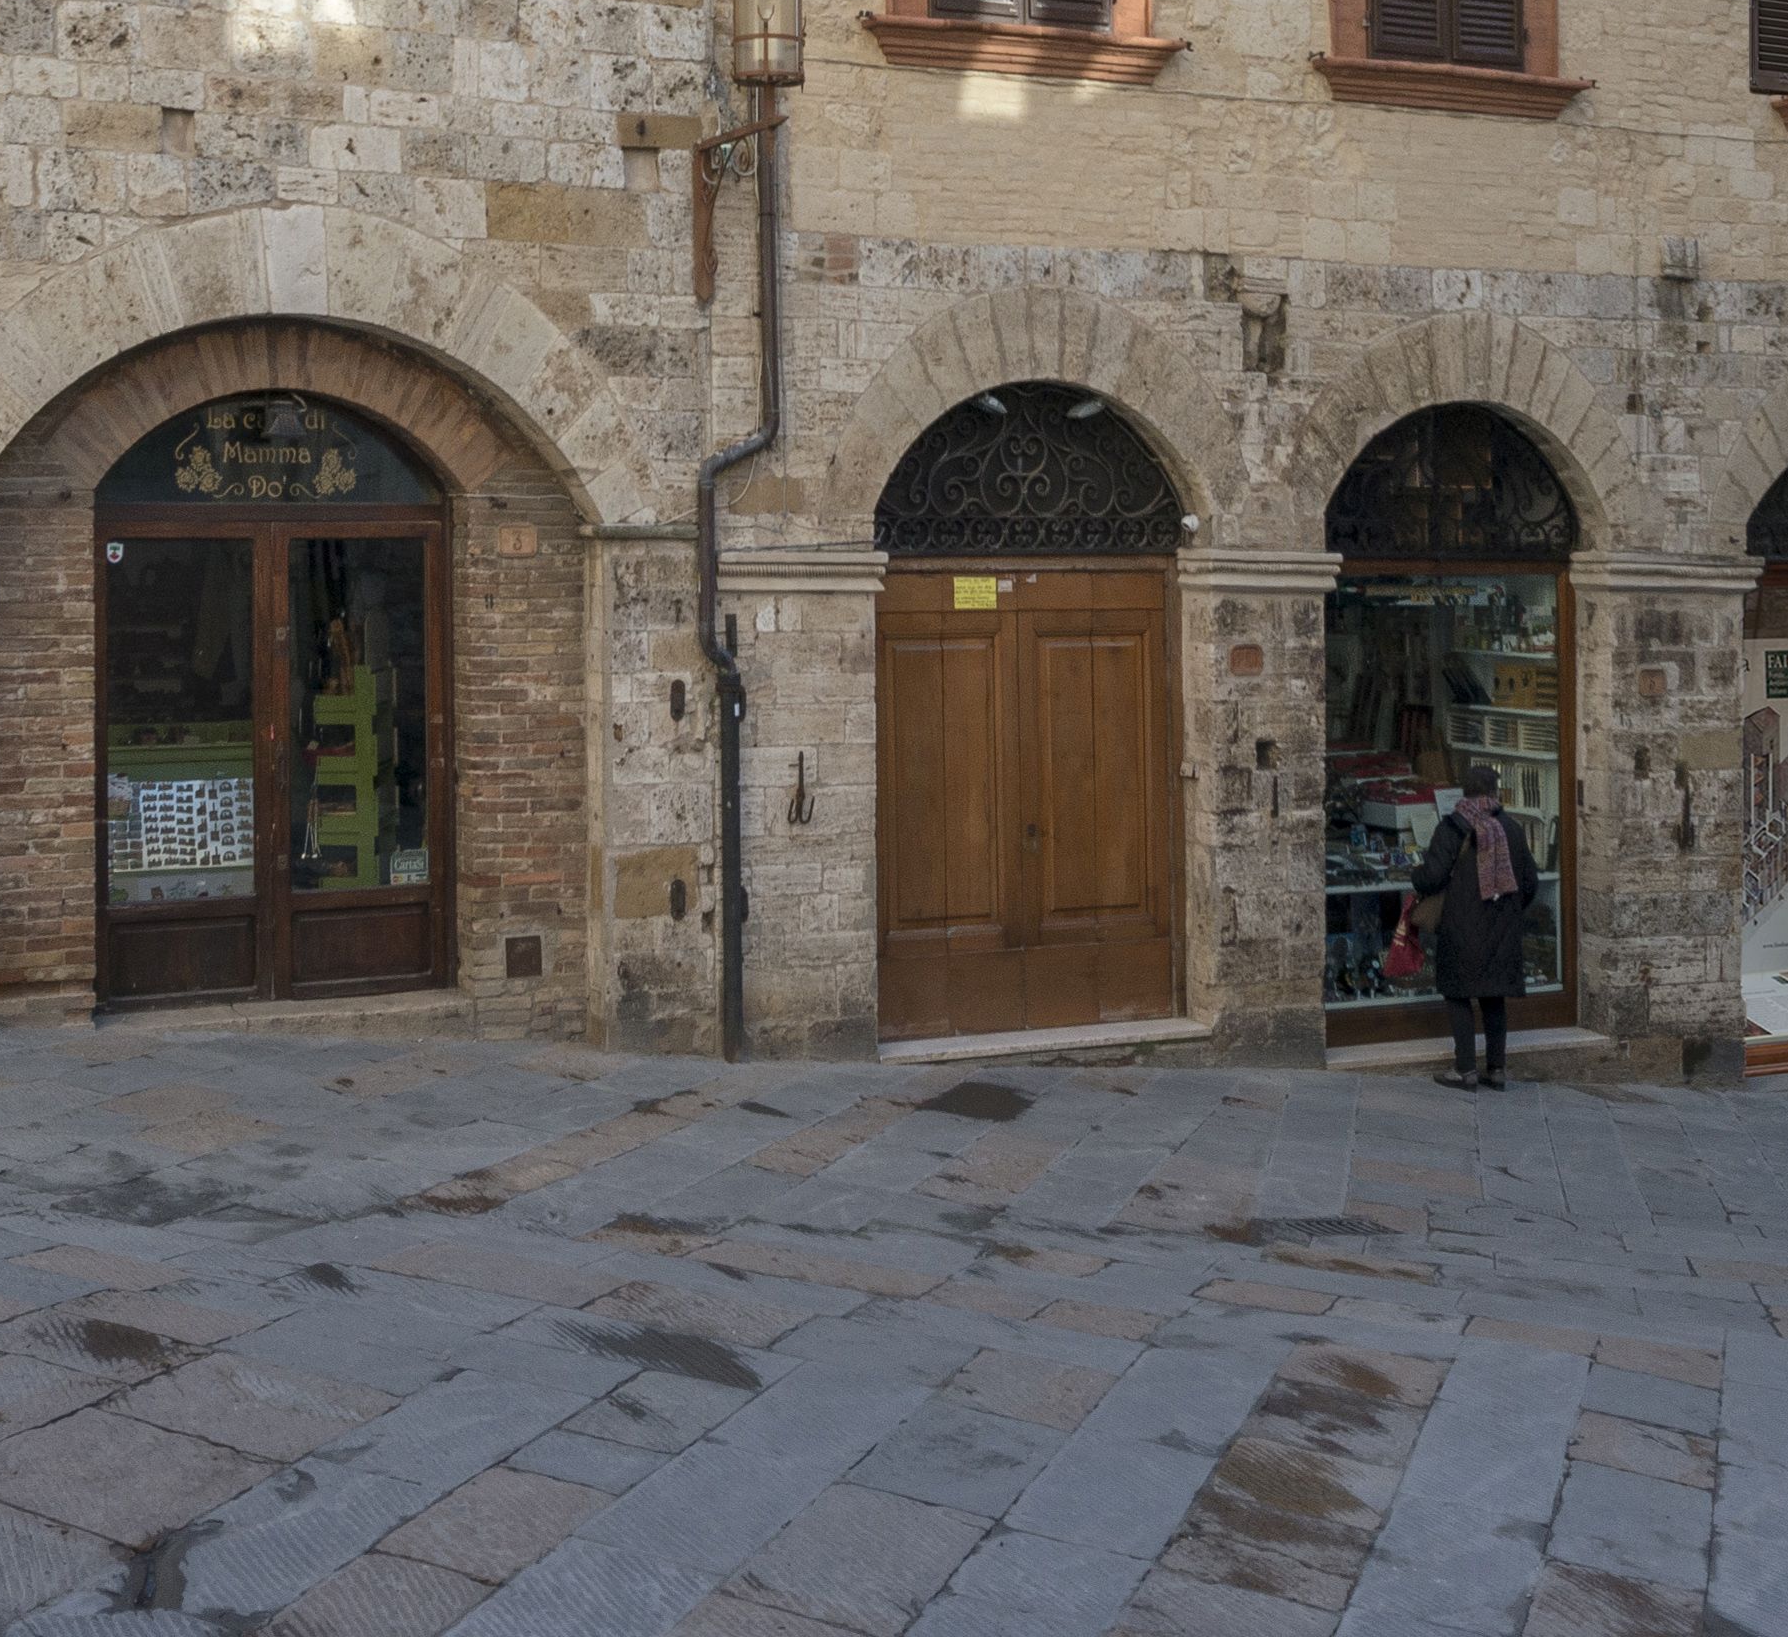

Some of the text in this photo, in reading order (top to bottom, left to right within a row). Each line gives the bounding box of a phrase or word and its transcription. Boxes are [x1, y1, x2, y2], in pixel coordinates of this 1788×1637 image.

[206, 409, 236, 429] La
[305, 409, 325, 429] di
[223, 441, 311, 464] Mamma
[247, 475, 287, 498] Do'
[1767, 654, 1788, 669] FAI
